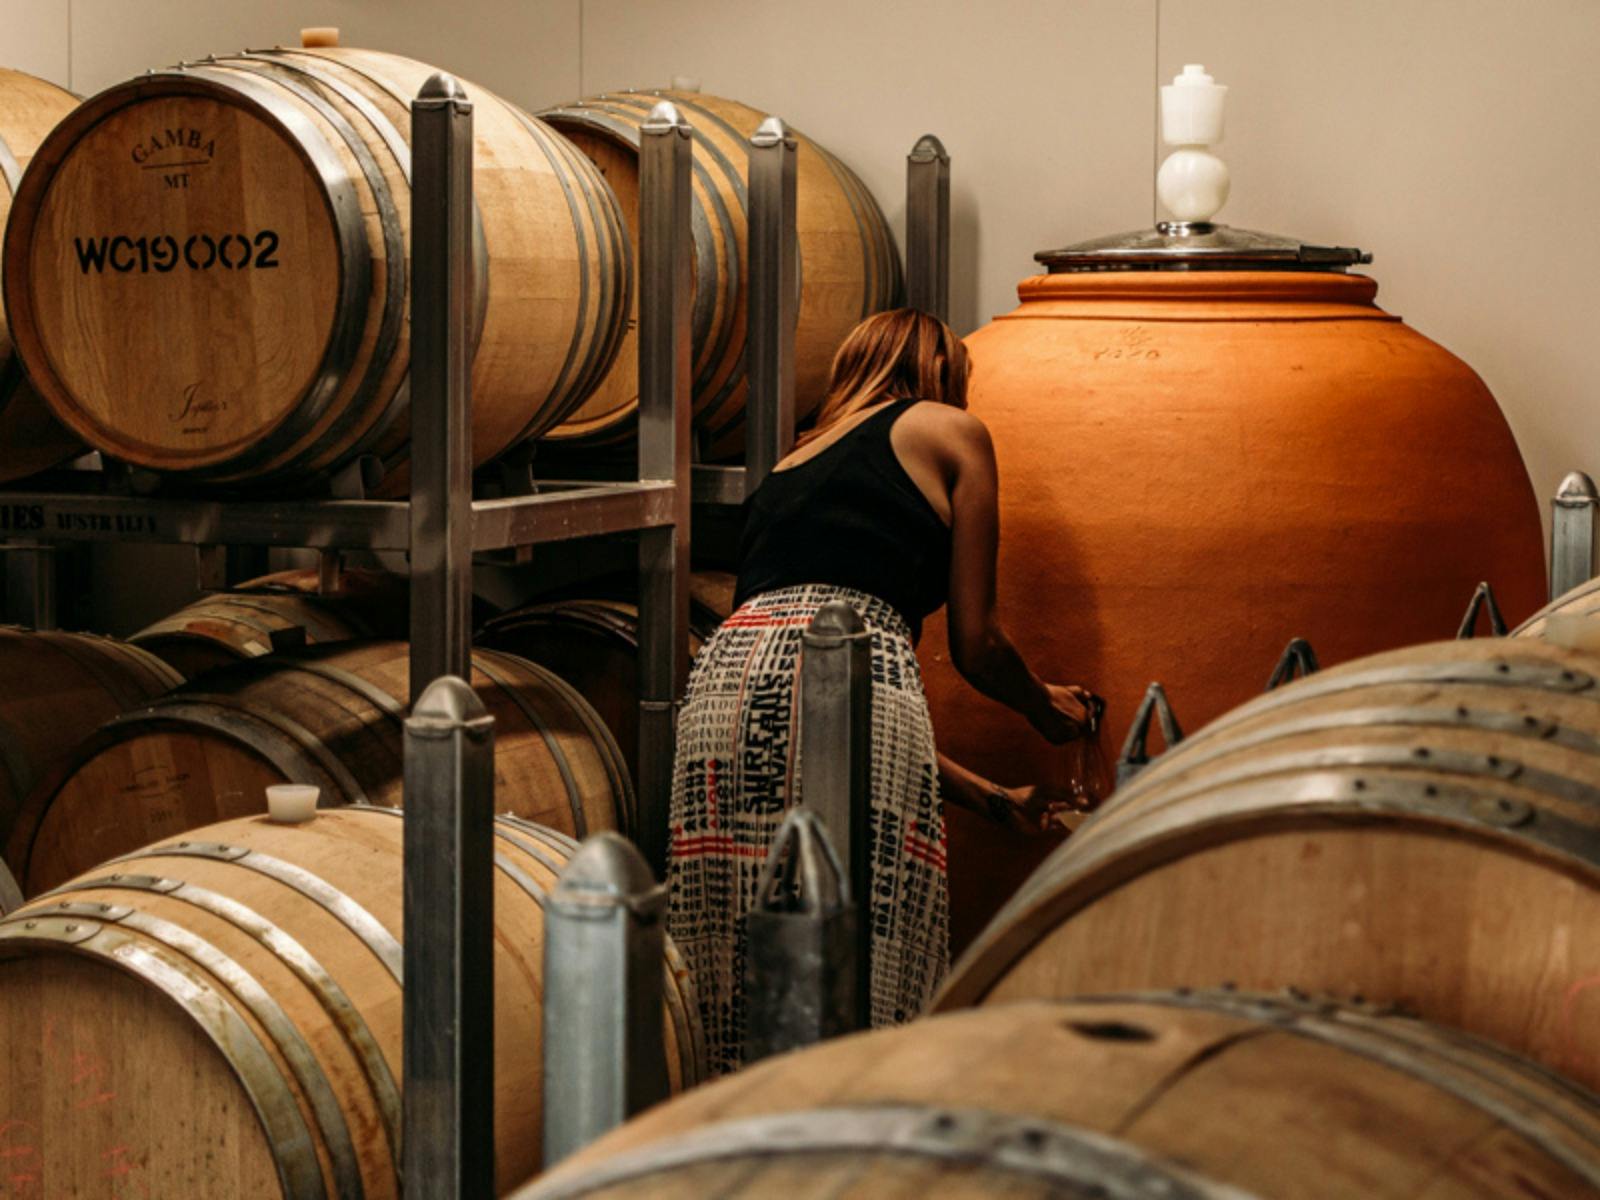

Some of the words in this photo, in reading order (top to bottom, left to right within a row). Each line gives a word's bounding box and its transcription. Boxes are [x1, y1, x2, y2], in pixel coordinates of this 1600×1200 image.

[131, 128, 215, 163] GAMBA
[164, 174, 191, 189] MT
[74, 230, 279, 274] WC19002
[697, 758, 708, 830] ALOHA
[917, 763, 932, 836] ALOHA
